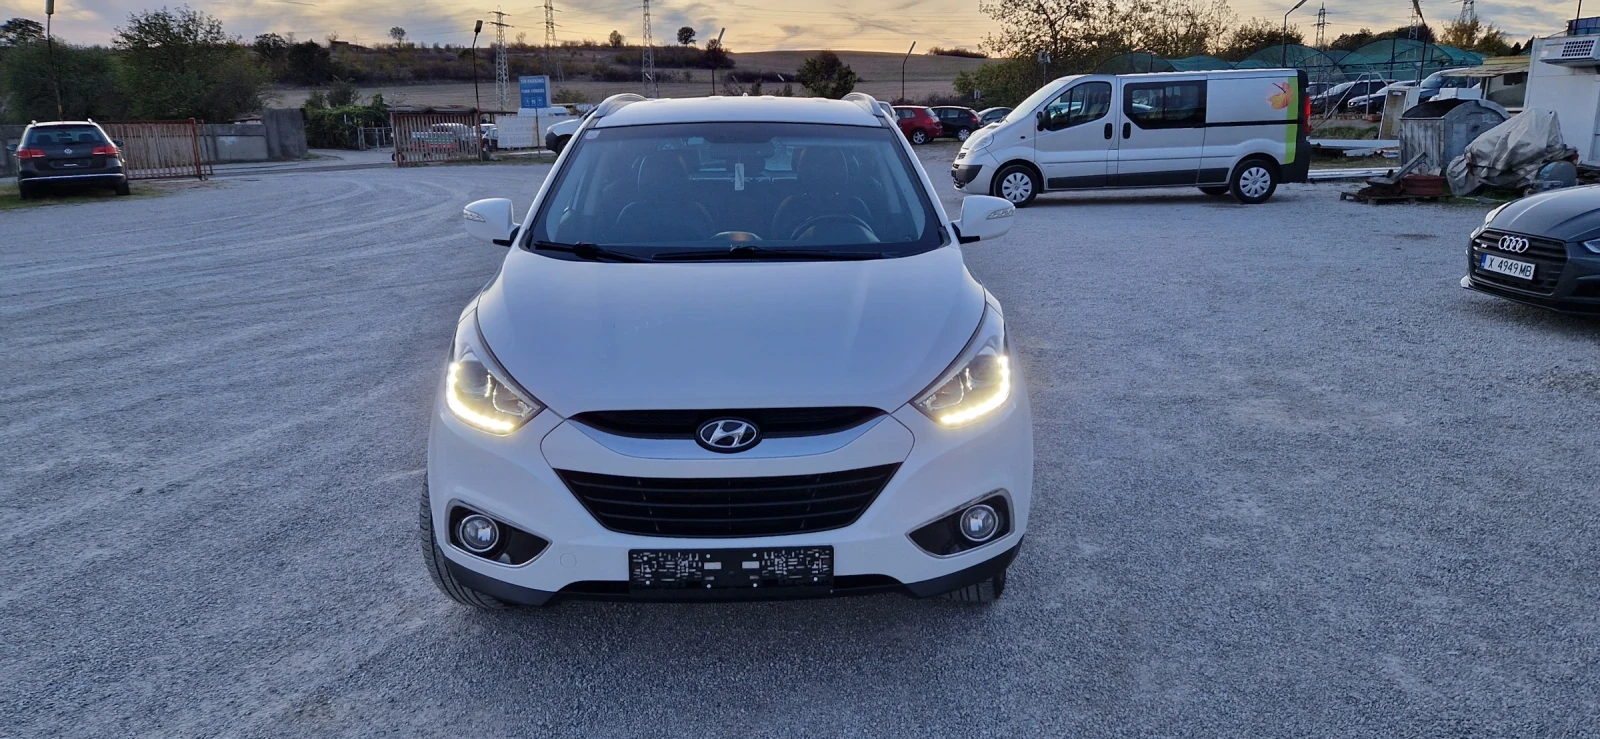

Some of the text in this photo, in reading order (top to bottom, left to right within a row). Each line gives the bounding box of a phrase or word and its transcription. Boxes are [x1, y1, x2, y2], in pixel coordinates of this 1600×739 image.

[1488, 257, 1532, 277] X 4949 MB
